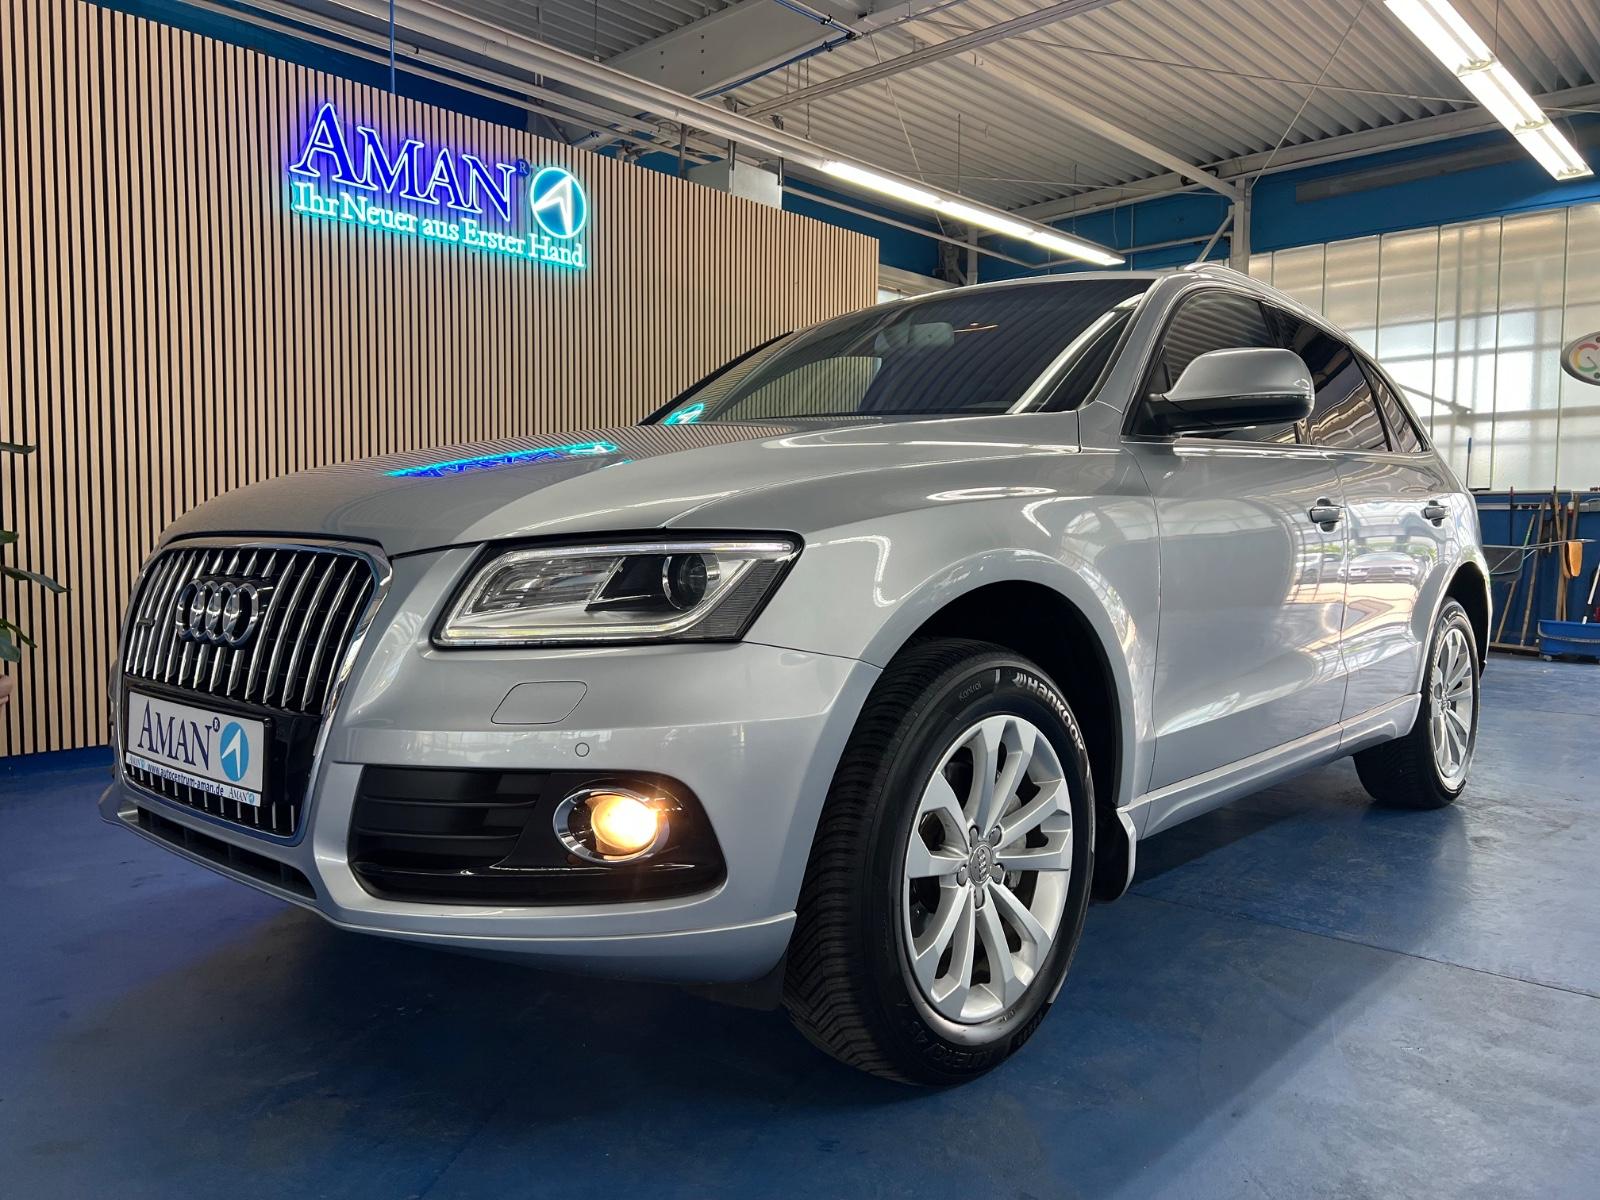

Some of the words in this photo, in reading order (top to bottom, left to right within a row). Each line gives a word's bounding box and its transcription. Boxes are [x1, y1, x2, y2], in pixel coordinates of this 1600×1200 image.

[292, 182, 340, 217] Ihr
[340, 191, 418, 233] Neuer
[422, 218, 460, 244] aus
[461, 217, 527, 255] Erster
[527, 233, 586, 268] Hand
[147, 764, 224, 796] www.autocentrum-aman.de
